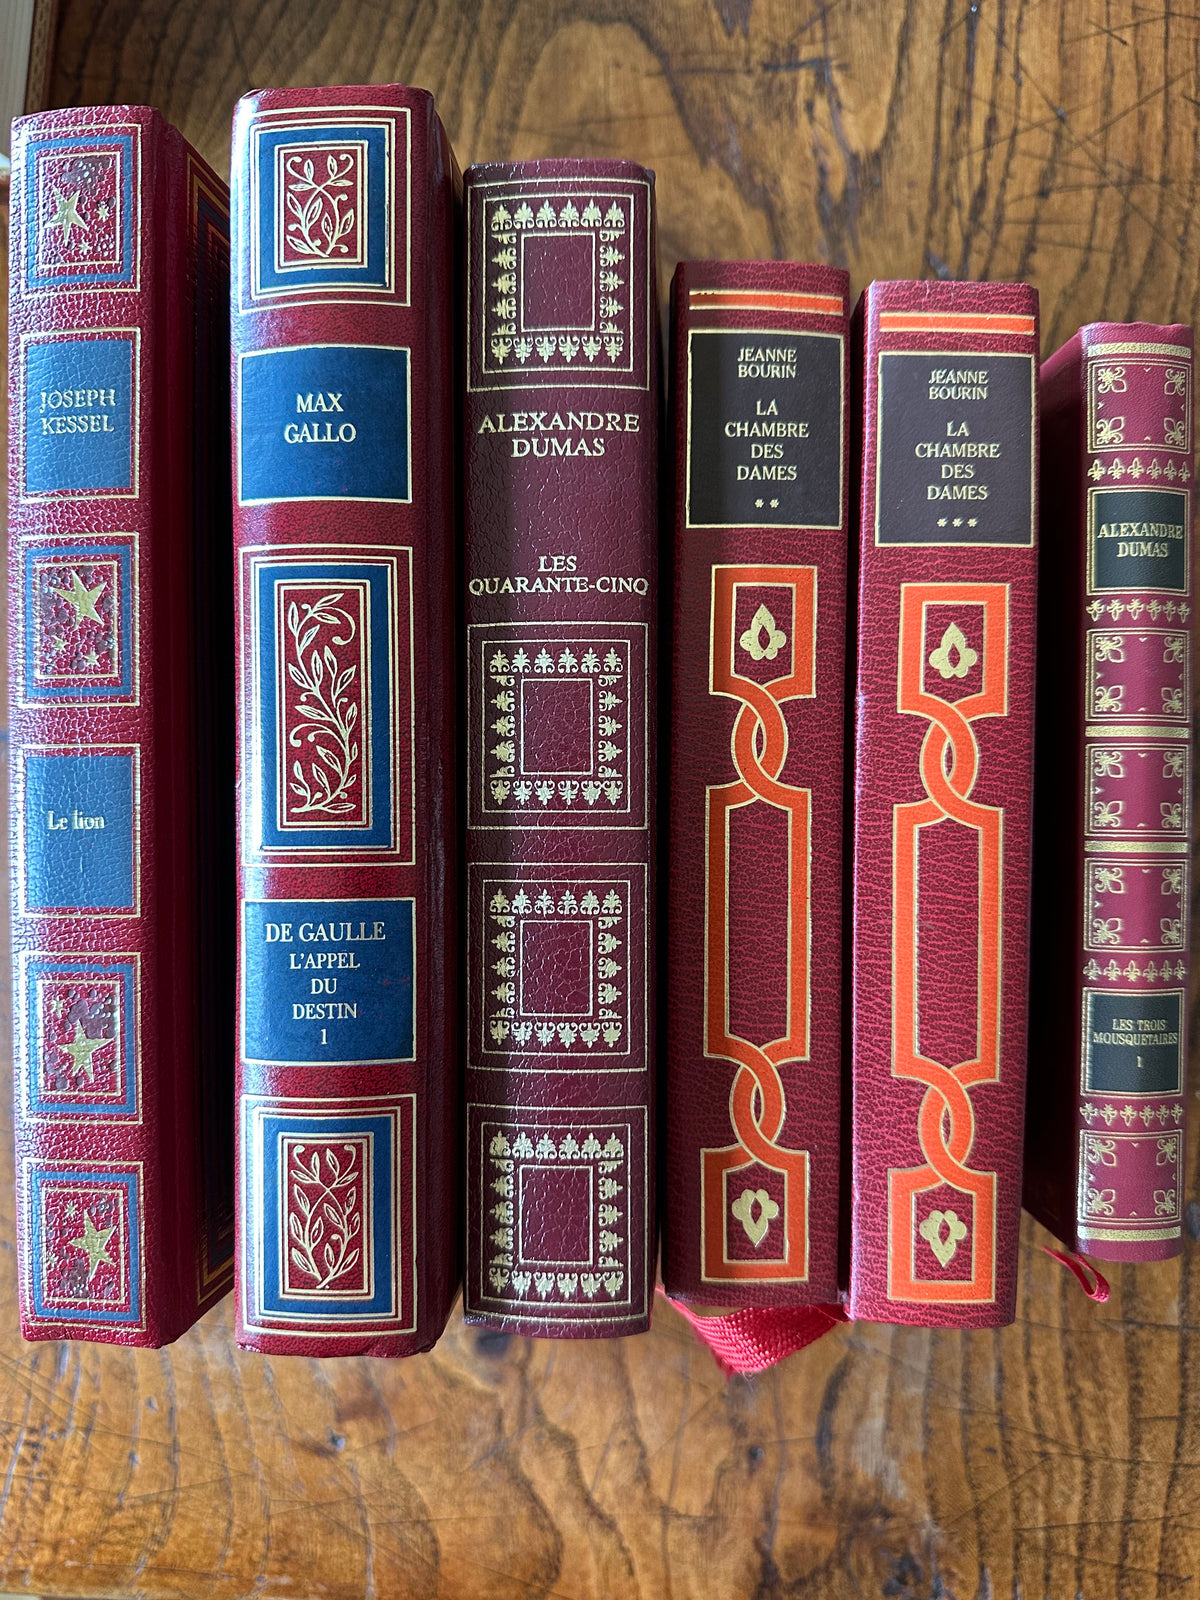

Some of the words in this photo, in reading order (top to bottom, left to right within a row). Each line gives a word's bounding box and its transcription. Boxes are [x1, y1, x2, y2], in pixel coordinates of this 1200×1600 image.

[738, 348, 797, 362] JEANNE
[738, 364, 797, 378] BOURIN
[928, 369, 988, 385] JEANNE
[38, 388, 116, 413] JOSEPH
[928, 386, 988, 400] BOURIN
[296, 392, 344, 413] MAX
[756, 399, 778, 416] LA
[41, 414, 114, 436] KESSEL
[477, 412, 640, 433] ALEXANDRE
[724, 422, 809, 438] CHAMBRE
[946, 421, 969, 437] LA
[284, 423, 357, 444] GALLO
[511, 437, 605, 458] DUMAS
[751, 444, 783, 459] DES
[915, 442, 1000, 458] CHAMBRE
[737, 465, 797, 481] DAMES
[941, 464, 974, 479] DES
[927, 485, 988, 501] DAMES
[1097, 522, 1183, 540] ALEXANDRE
[1116, 542, 1169, 558] DUMAS
[537, 555, 577, 573] LES
[468, 577, 649, 596] QUARANTE-CINQ
[47, 810, 68, 830] Le
[72, 810, 105, 829] lion
[265, 923, 293, 942] DE
[299, 922, 386, 942] GAULLE
[290, 952, 360, 970] L'APPEL
[311, 978, 337, 995] DU
[292, 1003, 357, 1020] DESTIN
[1112, 1018, 1134, 1031] LES
[1136, 1019, 1166, 1031] TROIS
[320, 1029, 328, 1045] 1
[1093, 1032, 1178, 1046] MOUSQUETAIRES
[1136, 1056, 1143, 1068] 1
